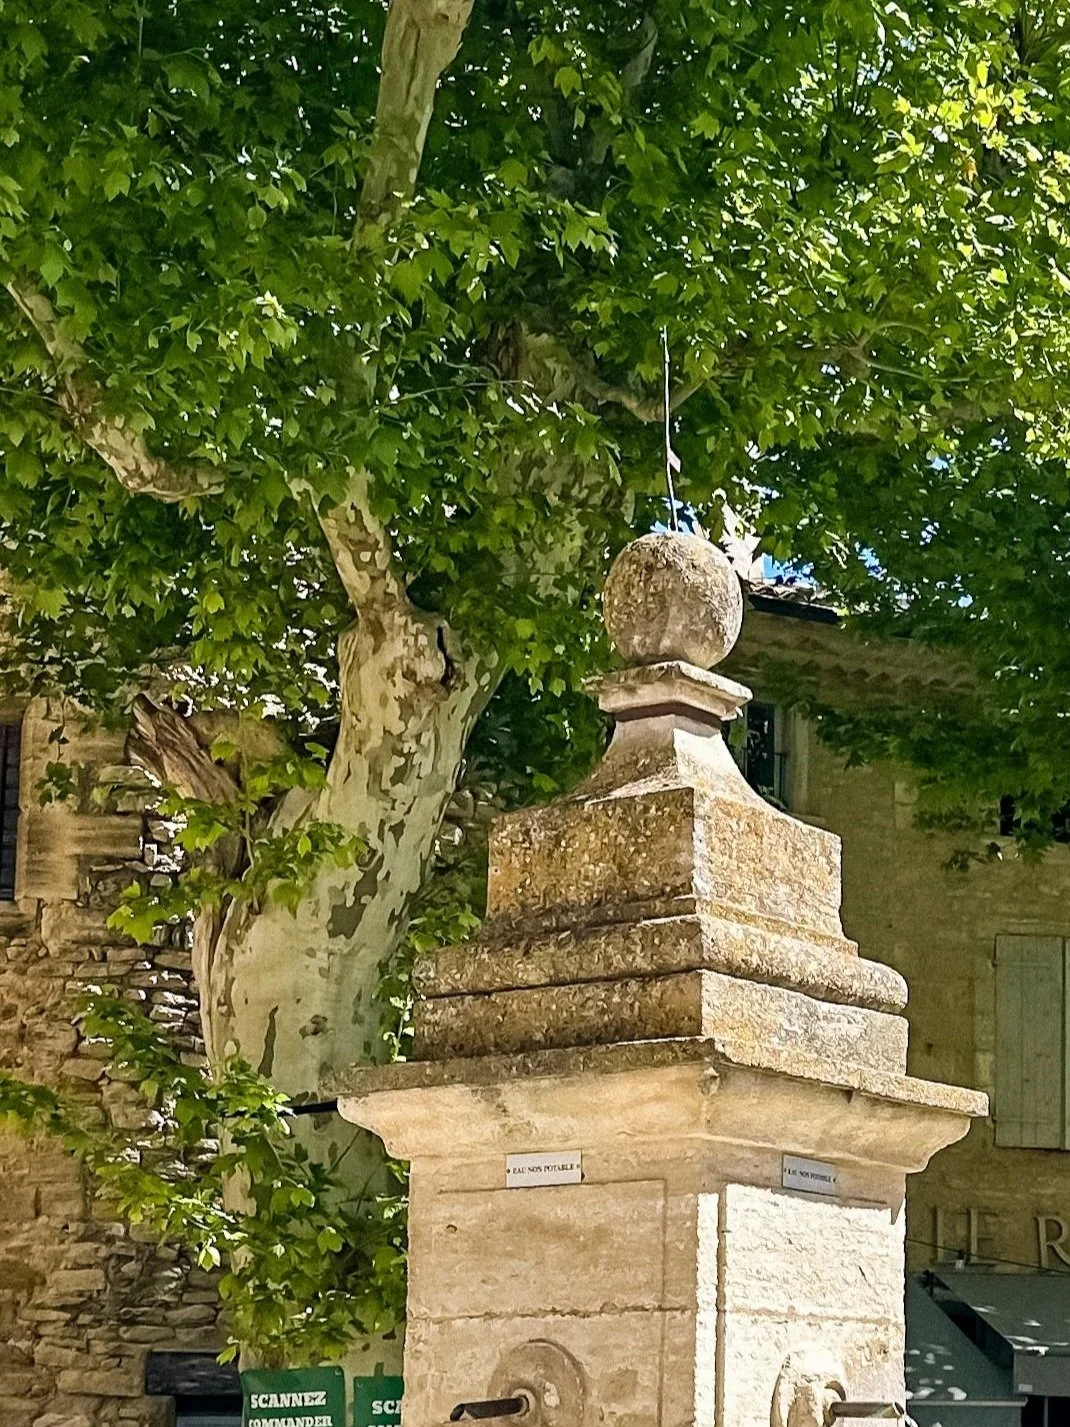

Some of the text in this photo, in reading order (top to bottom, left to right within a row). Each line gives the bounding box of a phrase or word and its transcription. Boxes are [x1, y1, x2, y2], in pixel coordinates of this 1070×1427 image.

[512, 1167, 526, 1175] EAU
[544, 1163, 574, 1172] POTABLE
[931, 1206, 998, 1267] LE
[250, 1391, 327, 1409] SCANNEZ
